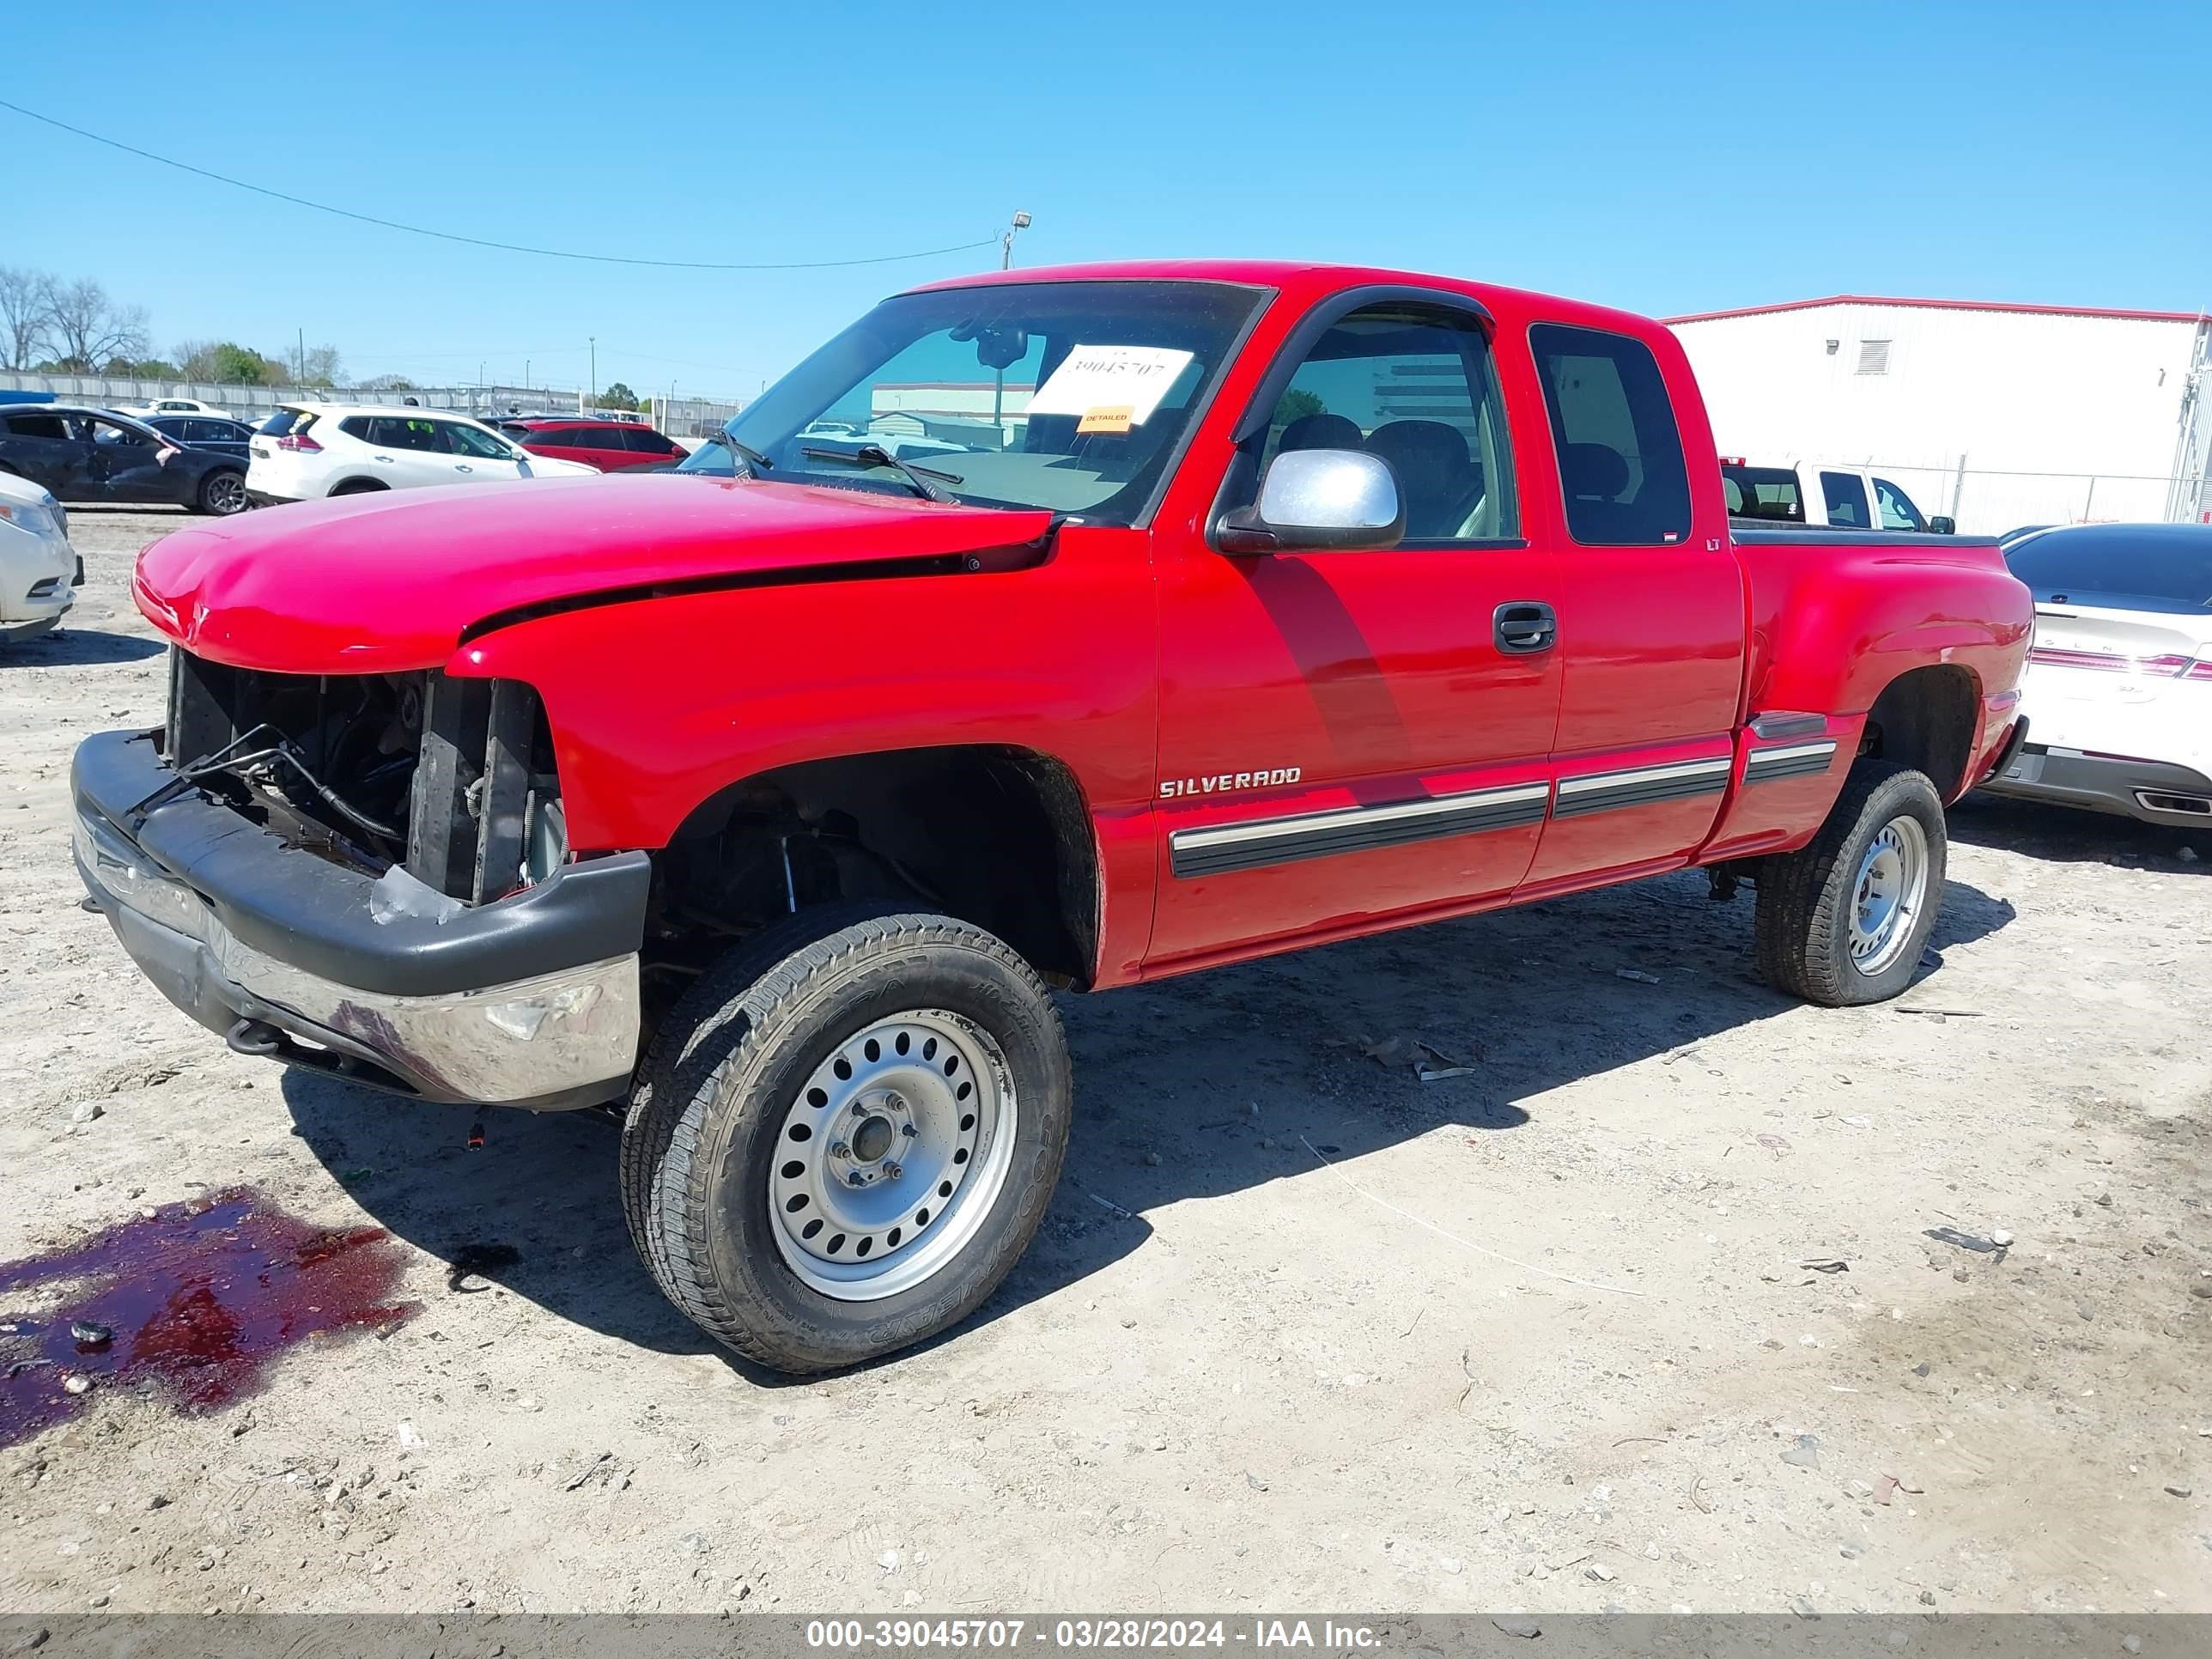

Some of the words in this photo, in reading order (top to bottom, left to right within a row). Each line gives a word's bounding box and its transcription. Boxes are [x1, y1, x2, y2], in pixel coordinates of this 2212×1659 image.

[1705, 538, 1720, 551] LT
[1158, 767, 1302, 799] SILVERADO
[869, 1113, 1055, 1344] GOODYEAR
